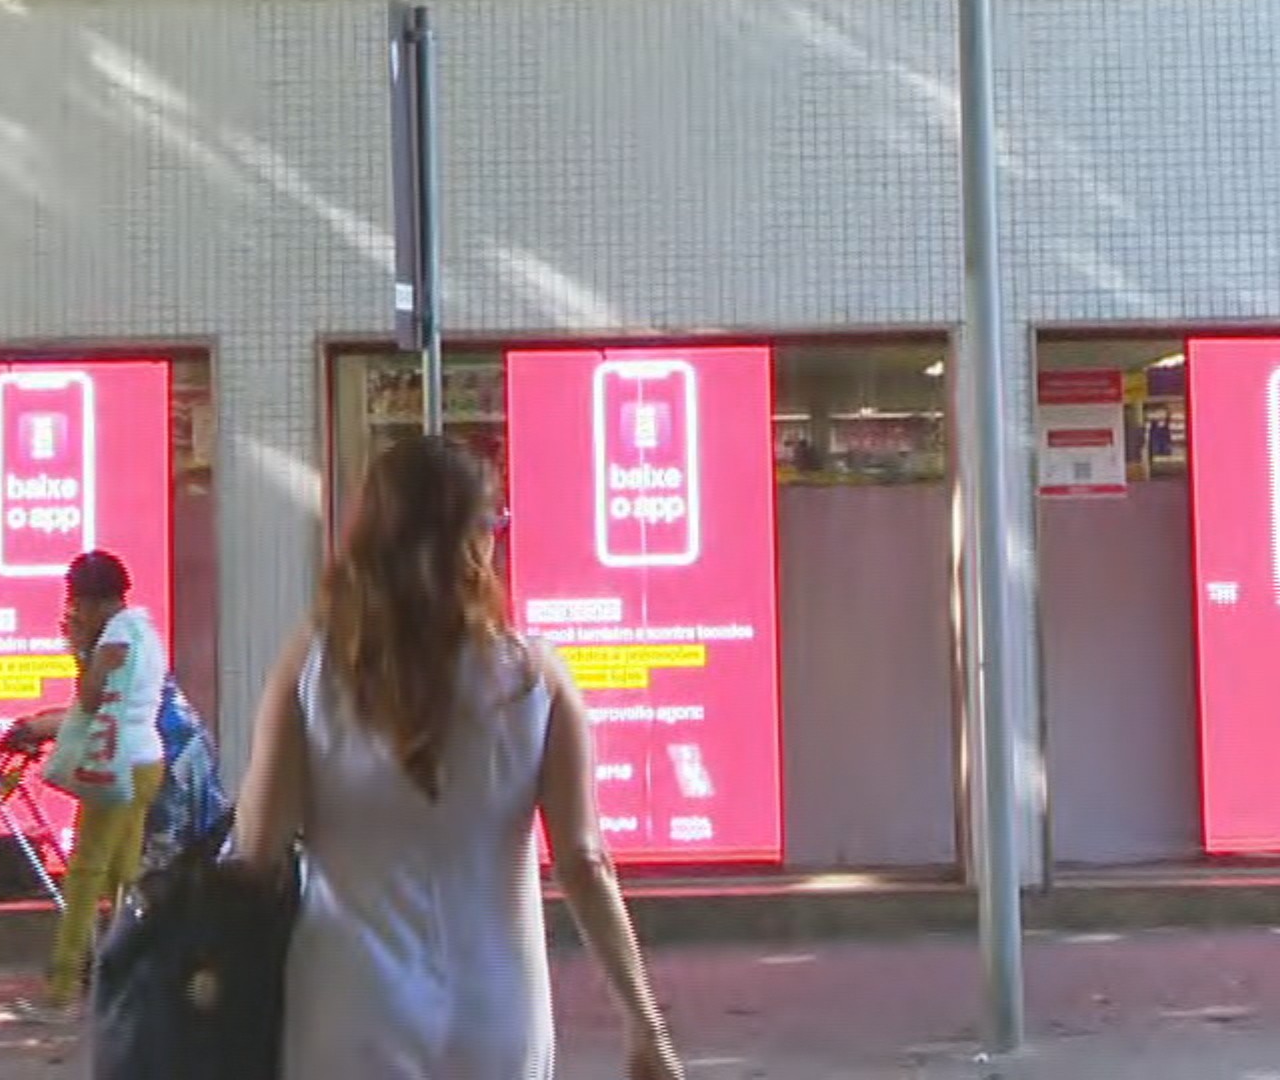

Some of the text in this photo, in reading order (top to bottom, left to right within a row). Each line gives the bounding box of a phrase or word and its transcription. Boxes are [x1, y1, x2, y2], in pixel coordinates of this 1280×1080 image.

[7, 472, 79, 500] baixe
[610, 462, 682, 490] baixe
[7, 506, 81, 533] o app
[610, 496, 685, 524] o app
